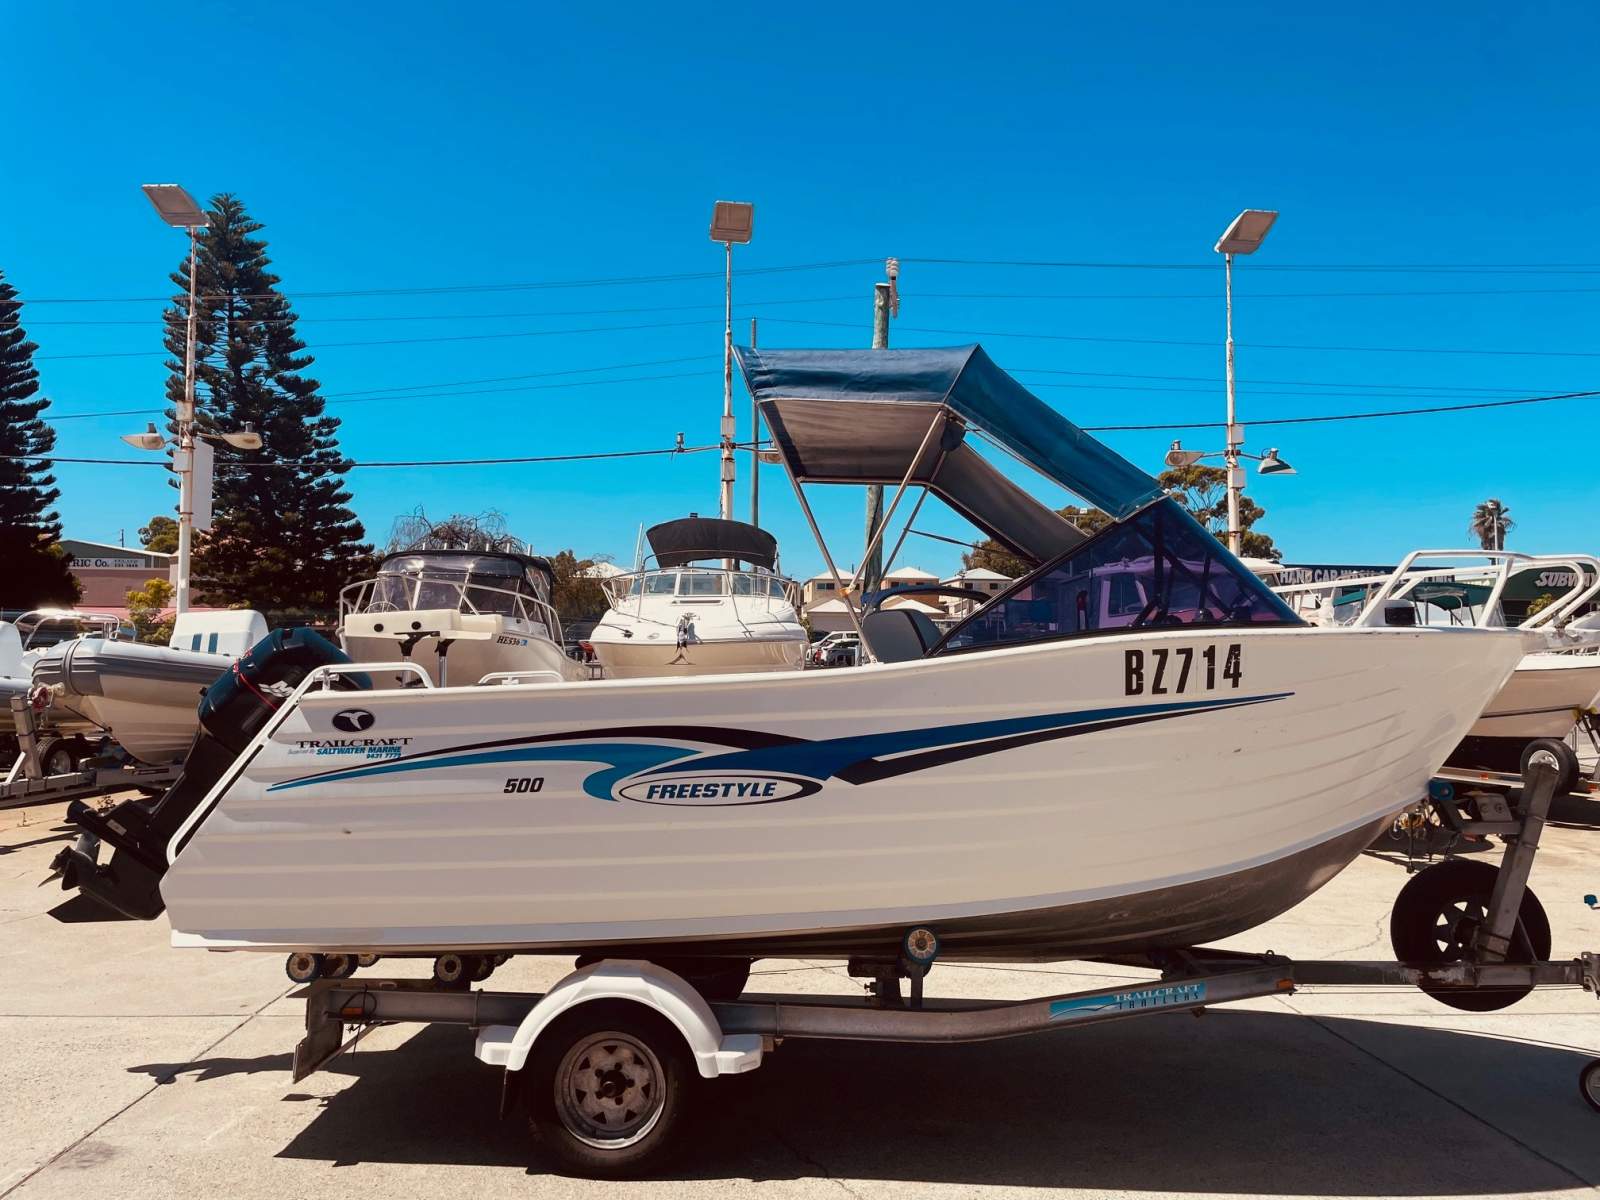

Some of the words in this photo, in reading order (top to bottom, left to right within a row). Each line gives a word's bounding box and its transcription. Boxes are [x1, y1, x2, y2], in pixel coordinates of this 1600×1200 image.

[67, 559, 91, 568] RIC
[95, 559, 110, 568] Co.
[1280, 570, 1312, 584] HAND
[1315, 569, 1338, 582] CAR
[1125, 643, 1242, 696] BZ714
[296, 737, 413, 748] TRAILCRAFT
[316, 747, 366, 755] SALTWATER
[367, 746, 402, 754] MARINE
[504, 777, 544, 793] 500
[646, 782, 777, 799] FREESTYLE
[1113, 984, 1201, 1001] TRAILCRAFT
[1118, 992, 1199, 1010] TRAILERS
